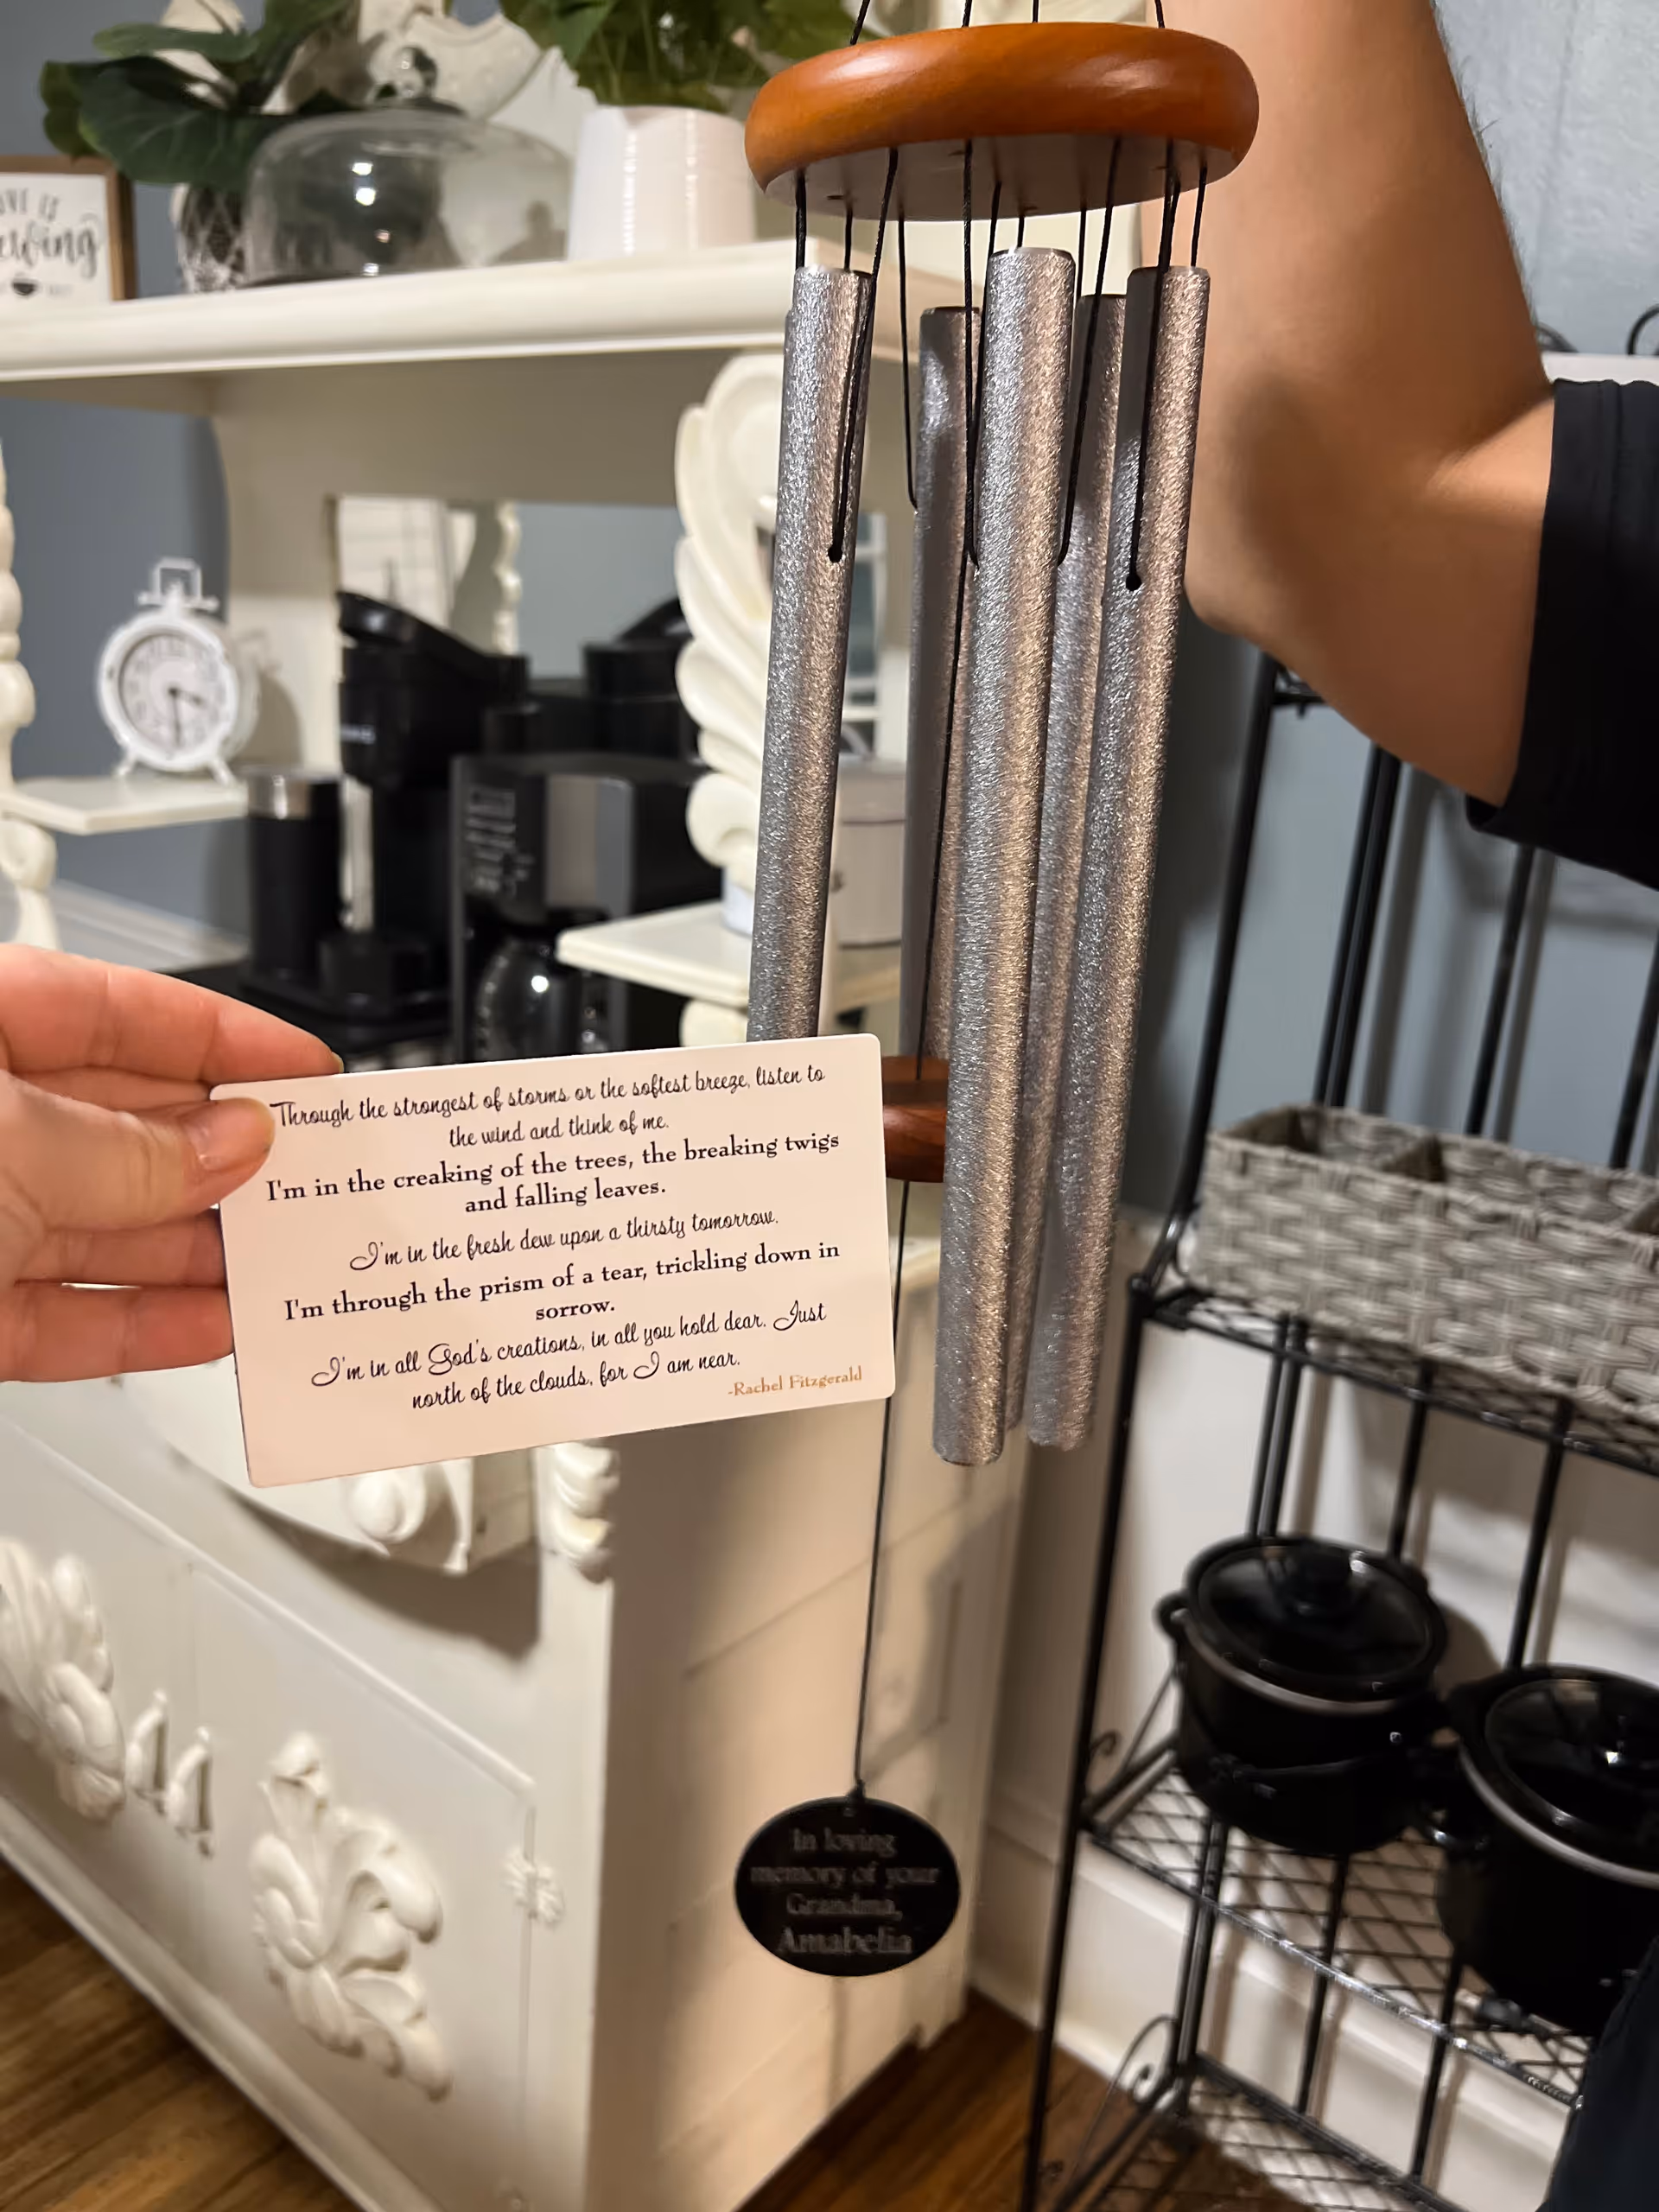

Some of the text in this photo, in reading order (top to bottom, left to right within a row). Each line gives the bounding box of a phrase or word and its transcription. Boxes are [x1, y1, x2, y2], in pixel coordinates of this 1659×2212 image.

[270, 1064, 826, 1128] Through the strongest of storms or the softest breeze, listen to
[448, 1109, 670, 1148] the wind and think of me.
[265, 1132, 840, 1202] I'm in the creaking of the trees, the breaking twigs
[465, 1176, 666, 1213] and falling leaves.
[349, 1211, 779, 1271] I'm in the fresh dew upon a thirsty tomorrow.
[283, 1241, 841, 1321] I'm through the prism of a tear, trickling down in
[535, 1300, 615, 1321] sorrow.
[310, 1299, 828, 1388] I'm in all God's creations, in all you hold dear. Just
[412, 1381, 467, 1409] north
[470, 1376, 492, 1405] of
[496, 1374, 526, 1398] the
[599, 1360, 629, 1388] for
[632, 1351, 660, 1381] I
[666, 1358, 695, 1374] am
[698, 1351, 741, 1370] near.
[728, 1365, 862, 1396] -Rachel Fitzgerald
[823, 1826, 897, 1857] loving
